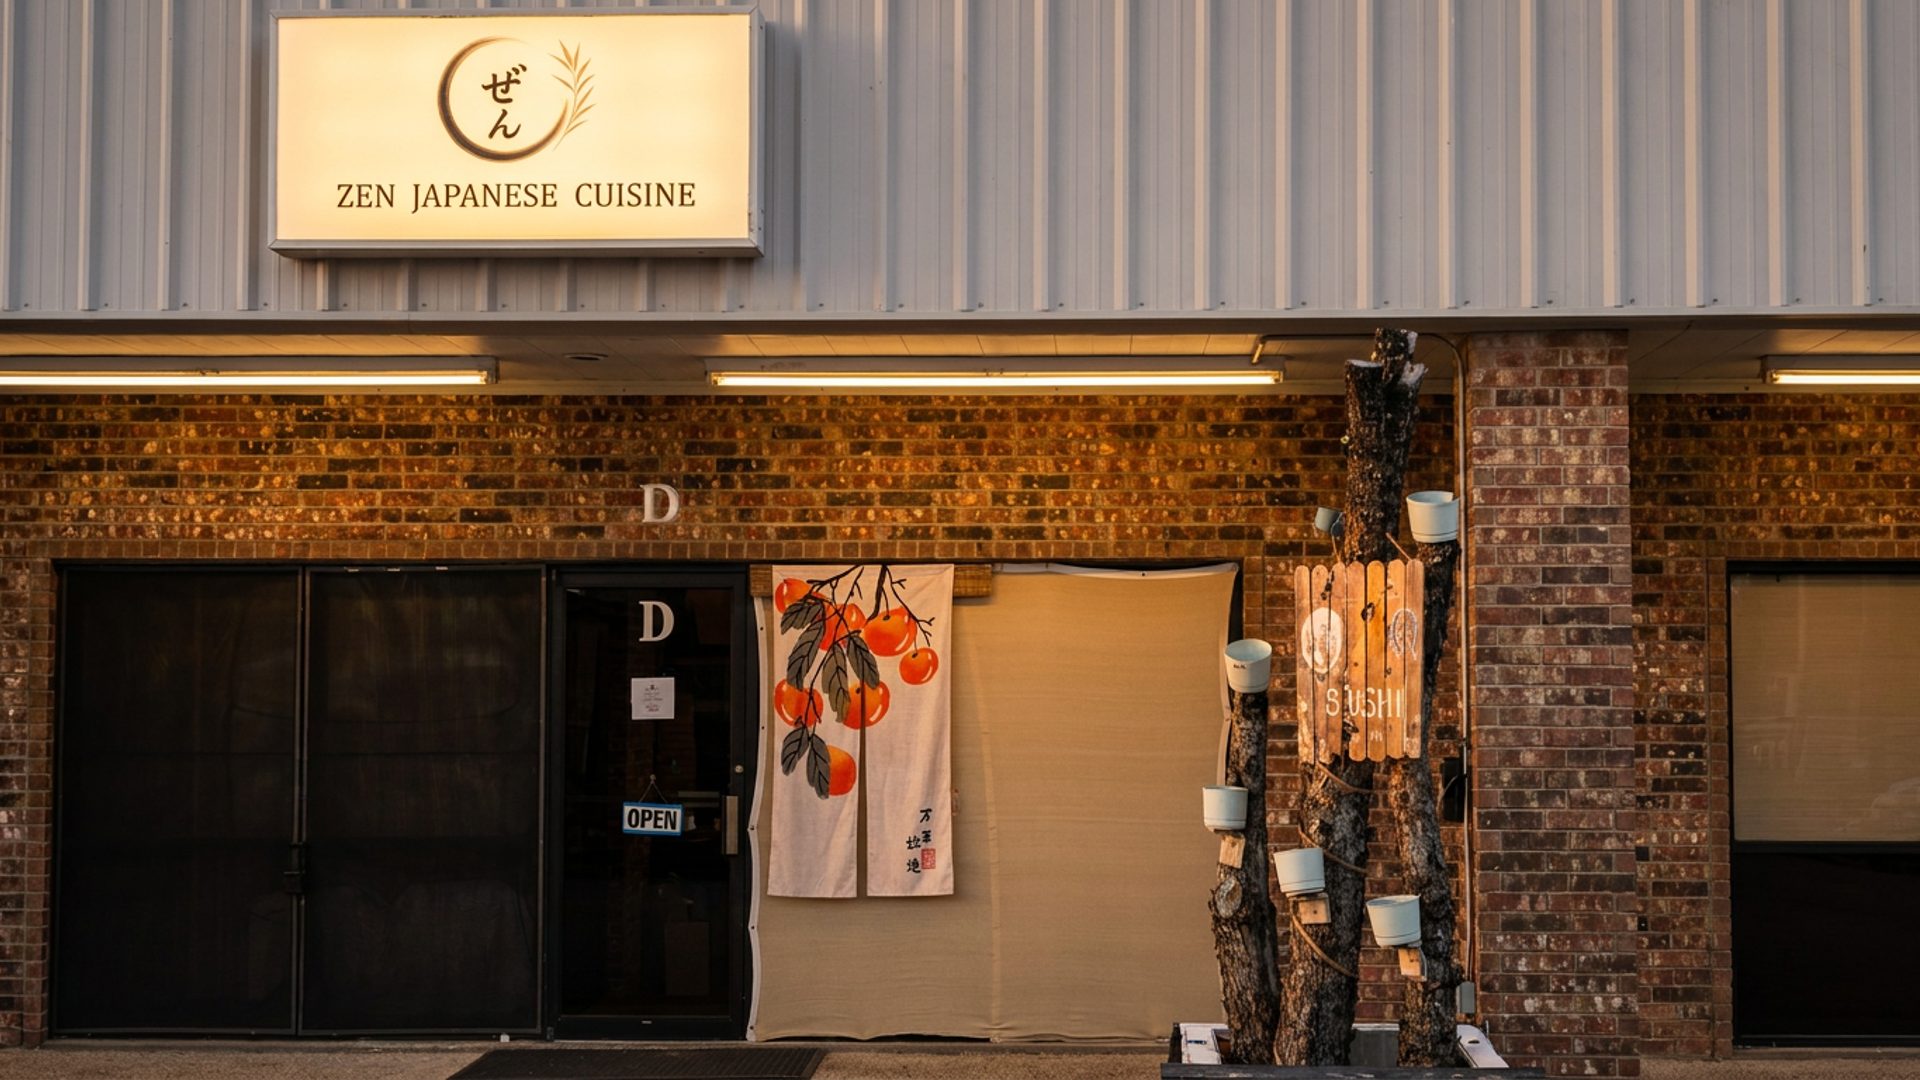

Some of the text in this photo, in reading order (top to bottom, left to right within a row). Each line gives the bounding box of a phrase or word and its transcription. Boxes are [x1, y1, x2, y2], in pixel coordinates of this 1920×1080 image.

[481, 63, 528, 140] ぜん
[336, 183, 697, 214] ZEN JAPANESE CUISINE
[640, 483, 680, 524] D
[638, 600, 675, 643] D
[1326, 685, 1403, 720] SUSHI
[627, 808, 678, 831] OPEN
